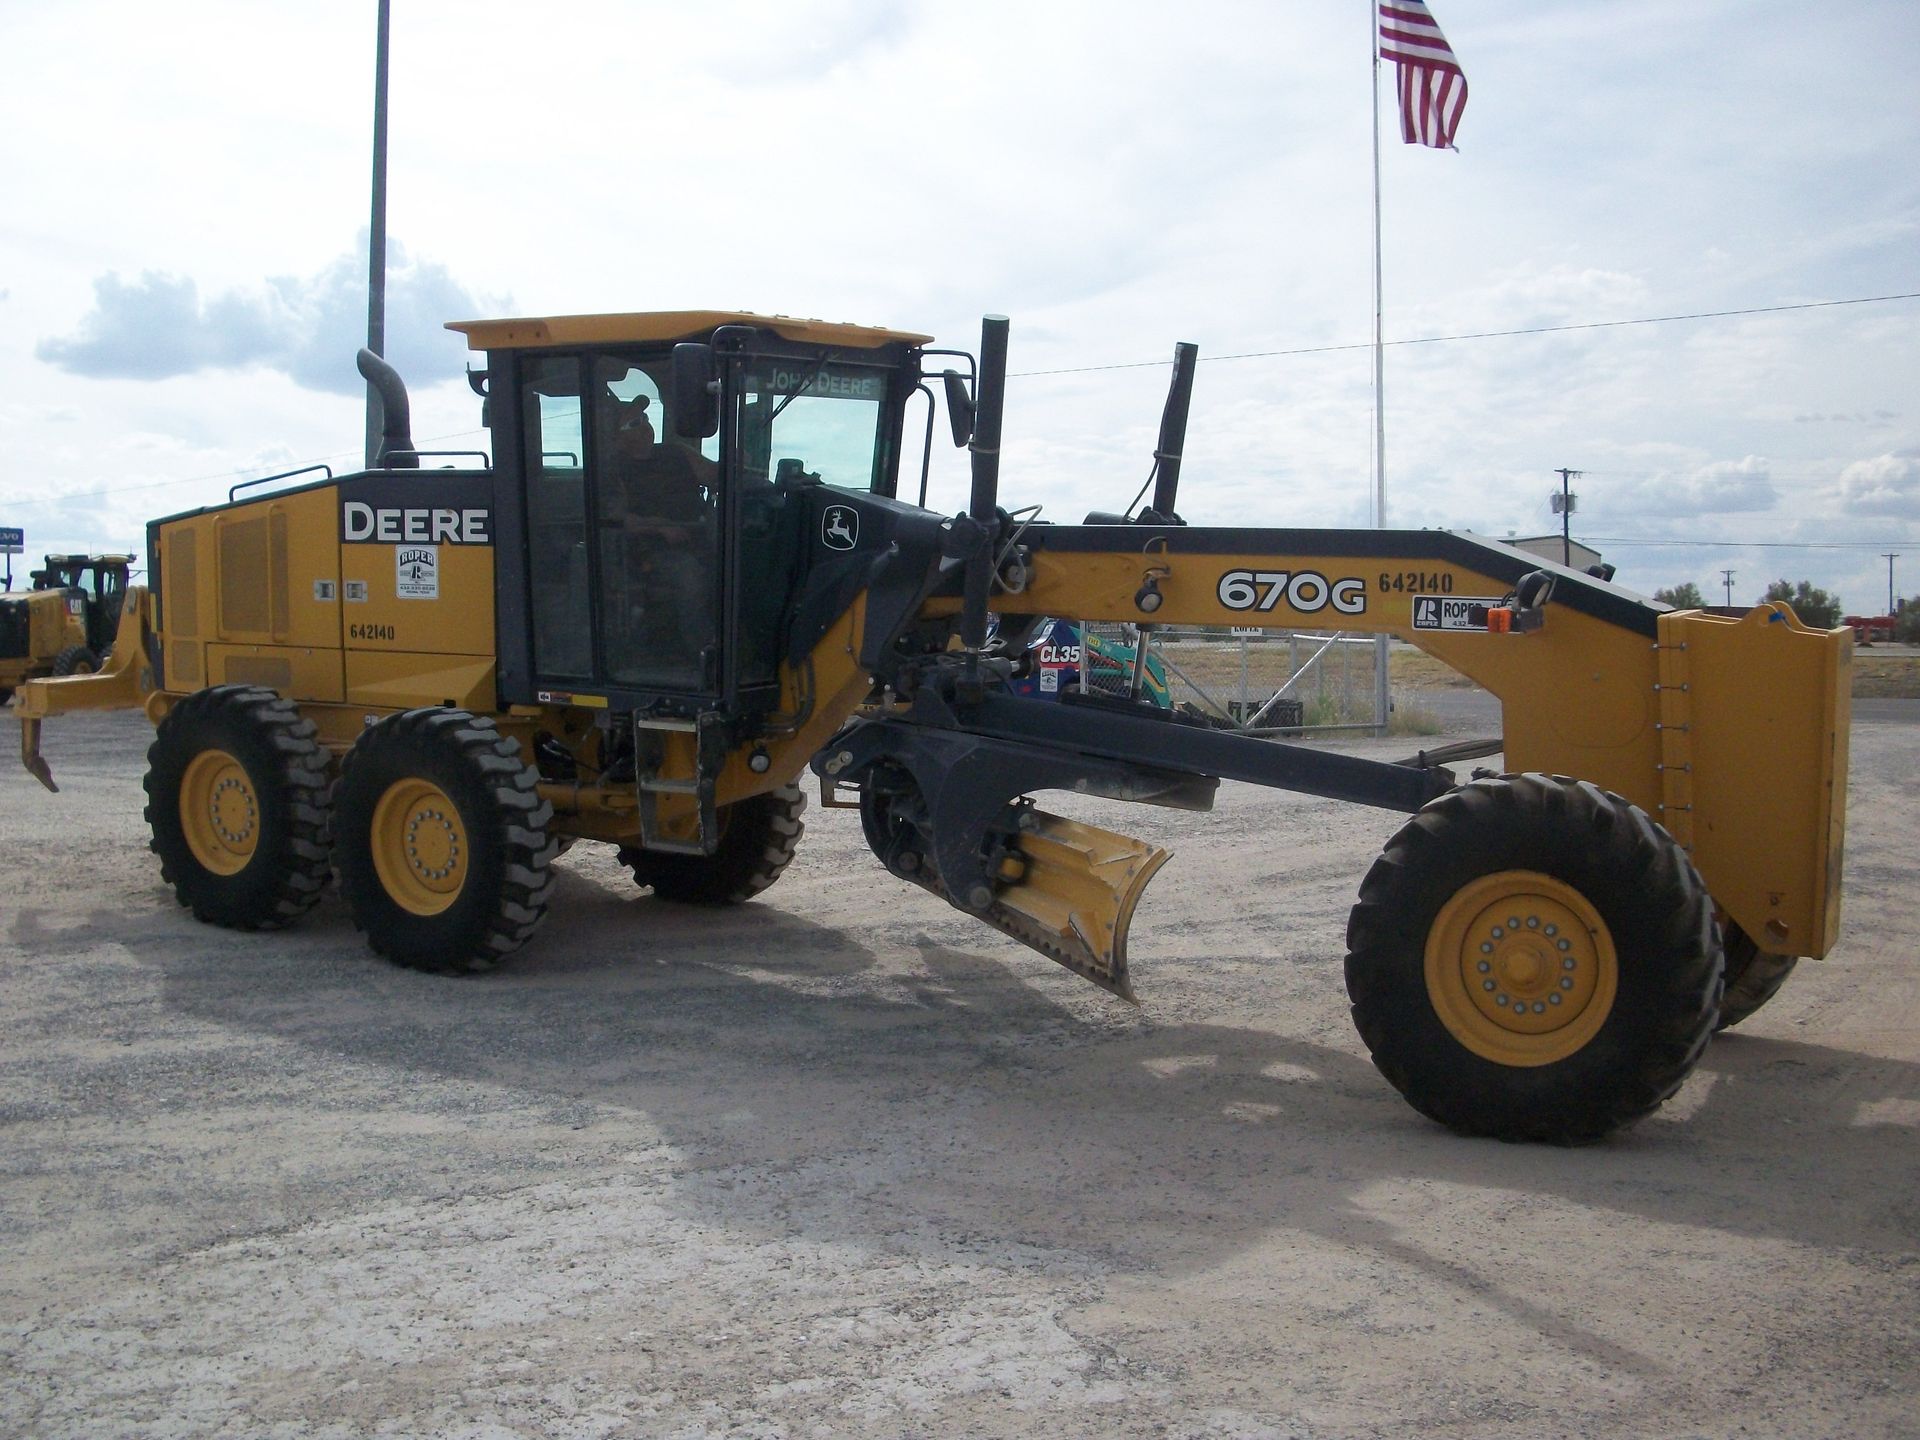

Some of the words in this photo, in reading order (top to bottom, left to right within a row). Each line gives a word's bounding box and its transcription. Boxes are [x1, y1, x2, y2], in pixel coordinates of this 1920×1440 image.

[766, 368, 813, 391] JOH
[818, 372, 871, 395] DEERE
[344, 502, 489, 542] DEERE
[400, 550, 435, 567] ROPER
[1217, 570, 1367, 614] 670G
[1379, 573, 1453, 593] 642140
[350, 624, 395, 640] 642140
[1040, 645, 1080, 663] CL35
